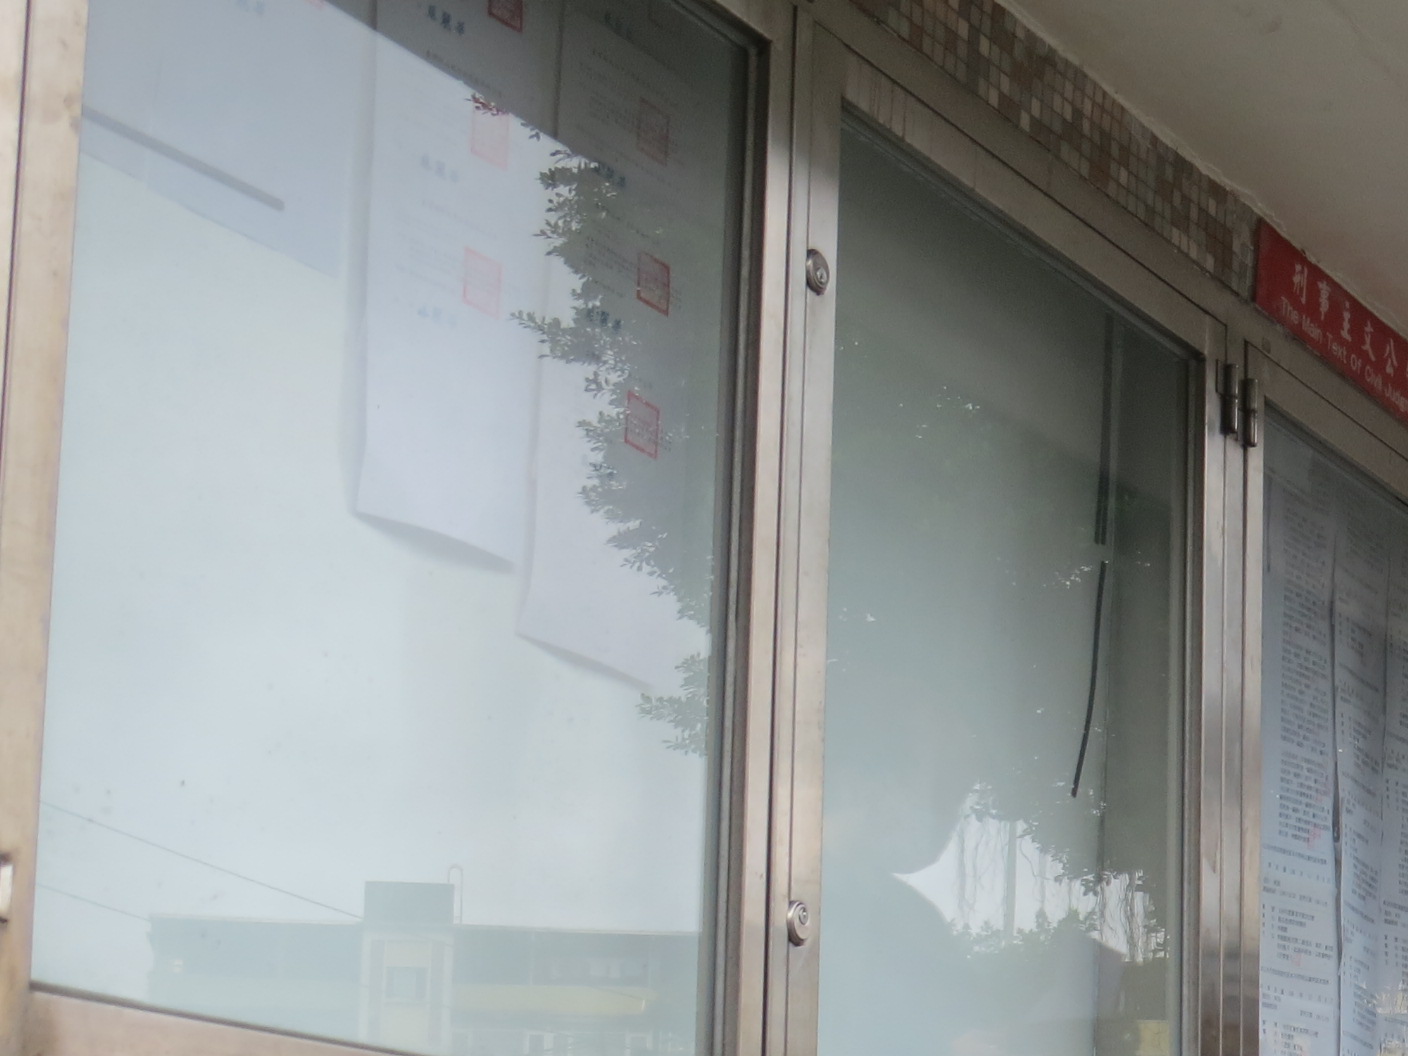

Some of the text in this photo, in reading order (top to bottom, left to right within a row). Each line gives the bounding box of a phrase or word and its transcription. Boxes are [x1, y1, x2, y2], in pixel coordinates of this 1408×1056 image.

[1279, 296, 1299, 324] The
[1302, 314, 1323, 344] Main
[1326, 331, 1347, 364] Text
[1350, 353, 1362, 375] Of
